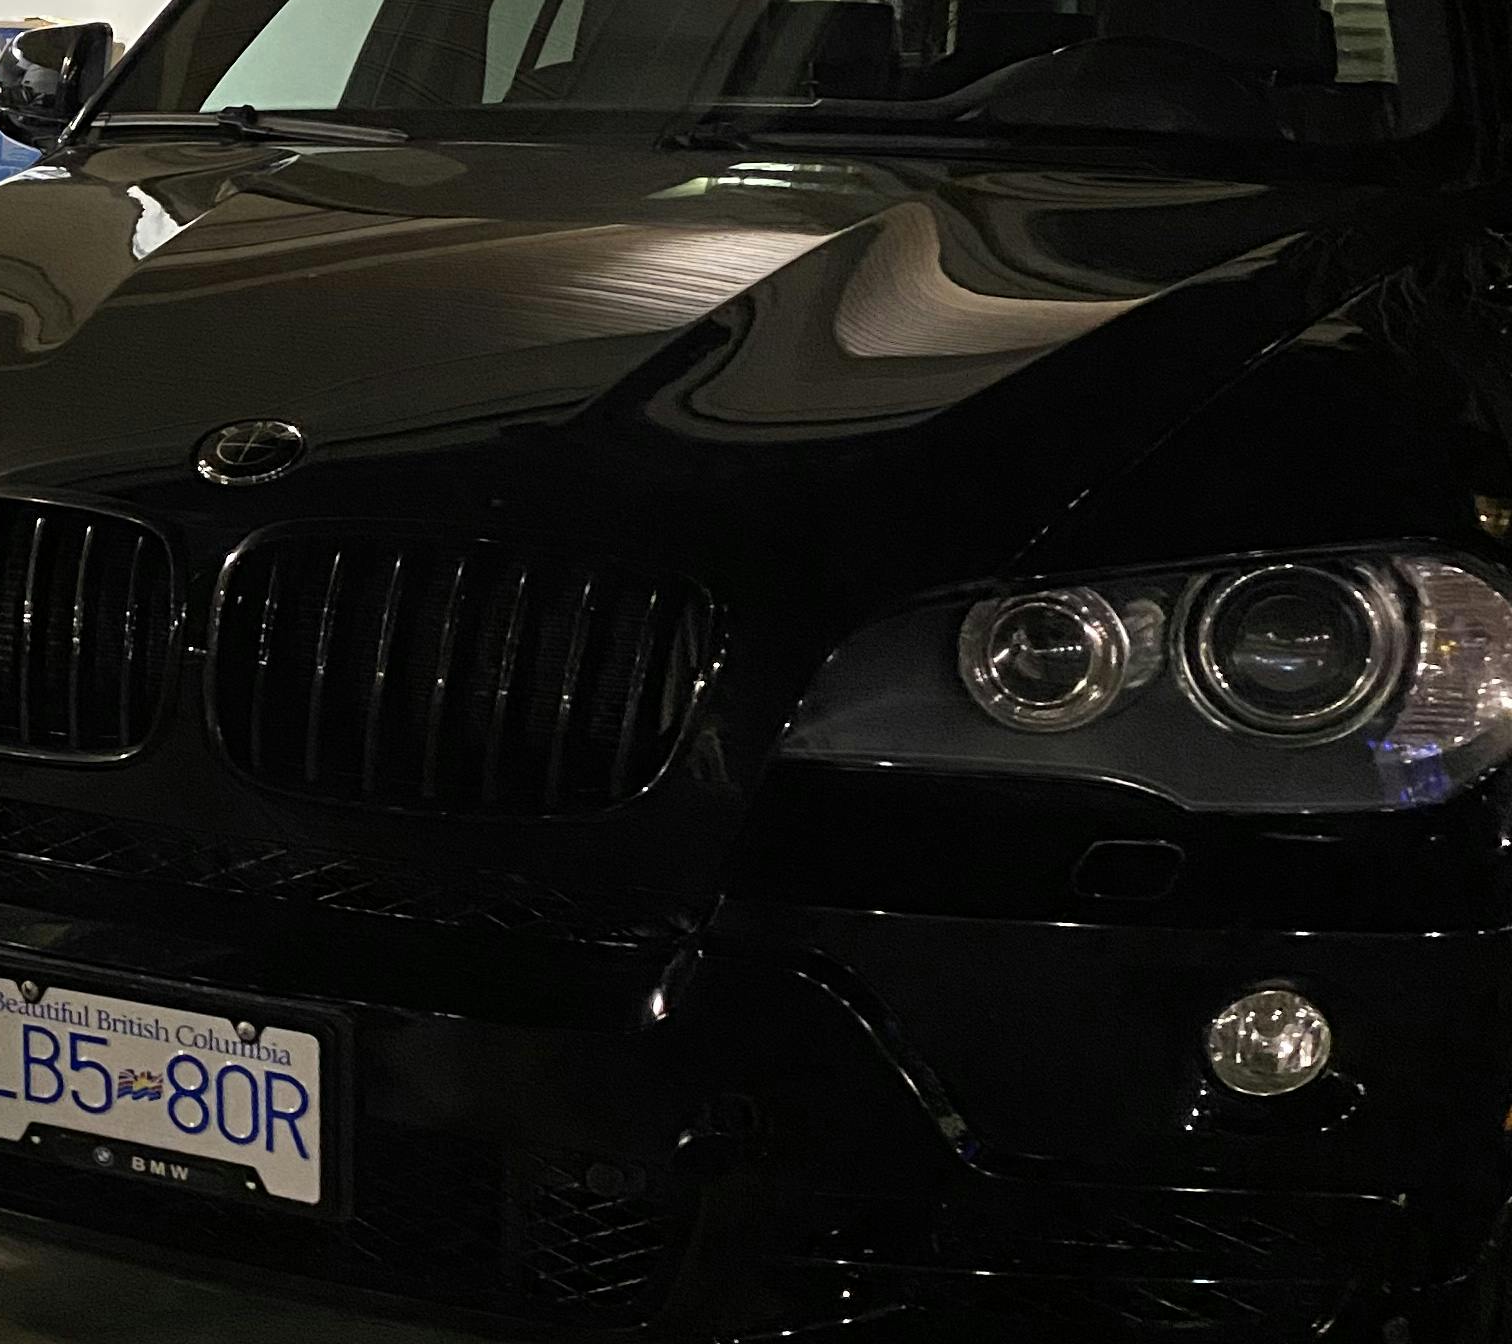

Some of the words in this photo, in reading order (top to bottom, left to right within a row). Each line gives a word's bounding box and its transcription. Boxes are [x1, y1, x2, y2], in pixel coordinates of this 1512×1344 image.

[96, 1009, 169, 1043] British
[176, 1025, 291, 1066] Columbia
[131, 1156, 189, 1181] BMW
